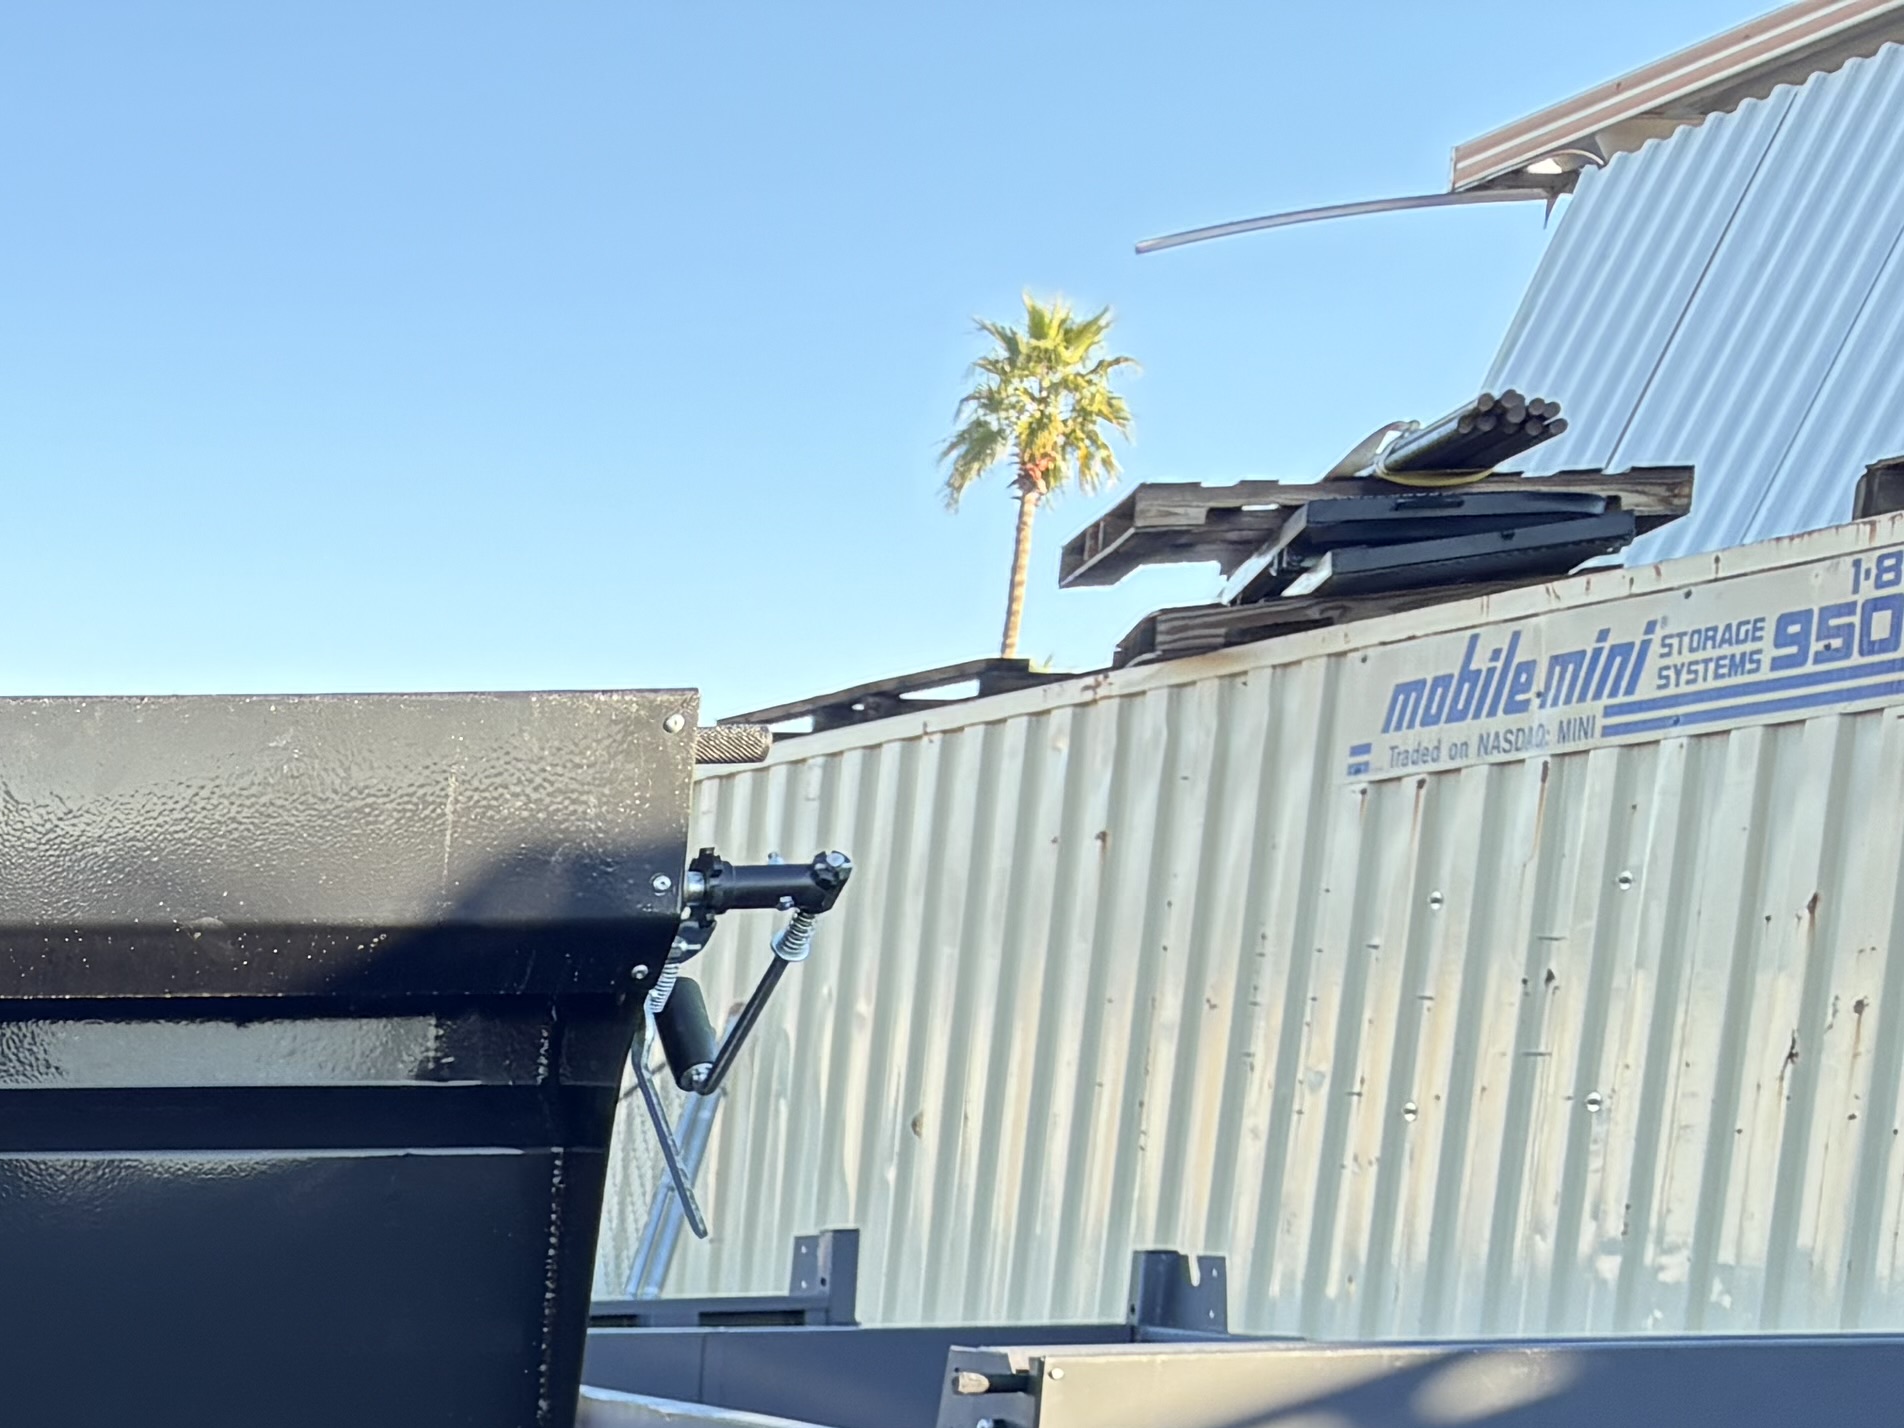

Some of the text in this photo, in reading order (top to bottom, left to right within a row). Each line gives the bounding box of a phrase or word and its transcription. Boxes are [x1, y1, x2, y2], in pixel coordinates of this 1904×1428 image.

[1658, 616, 1766, 658] STORAGE
[1769, 592, 1904, 671] 950
[1381, 619, 1659, 734] mobile mini
[1656, 648, 1763, 690] SYSTEMS
[1388, 738, 1441, 769] Traded
[1449, 741, 1469, 760] on
[1557, 714, 1596, 744] MINI
